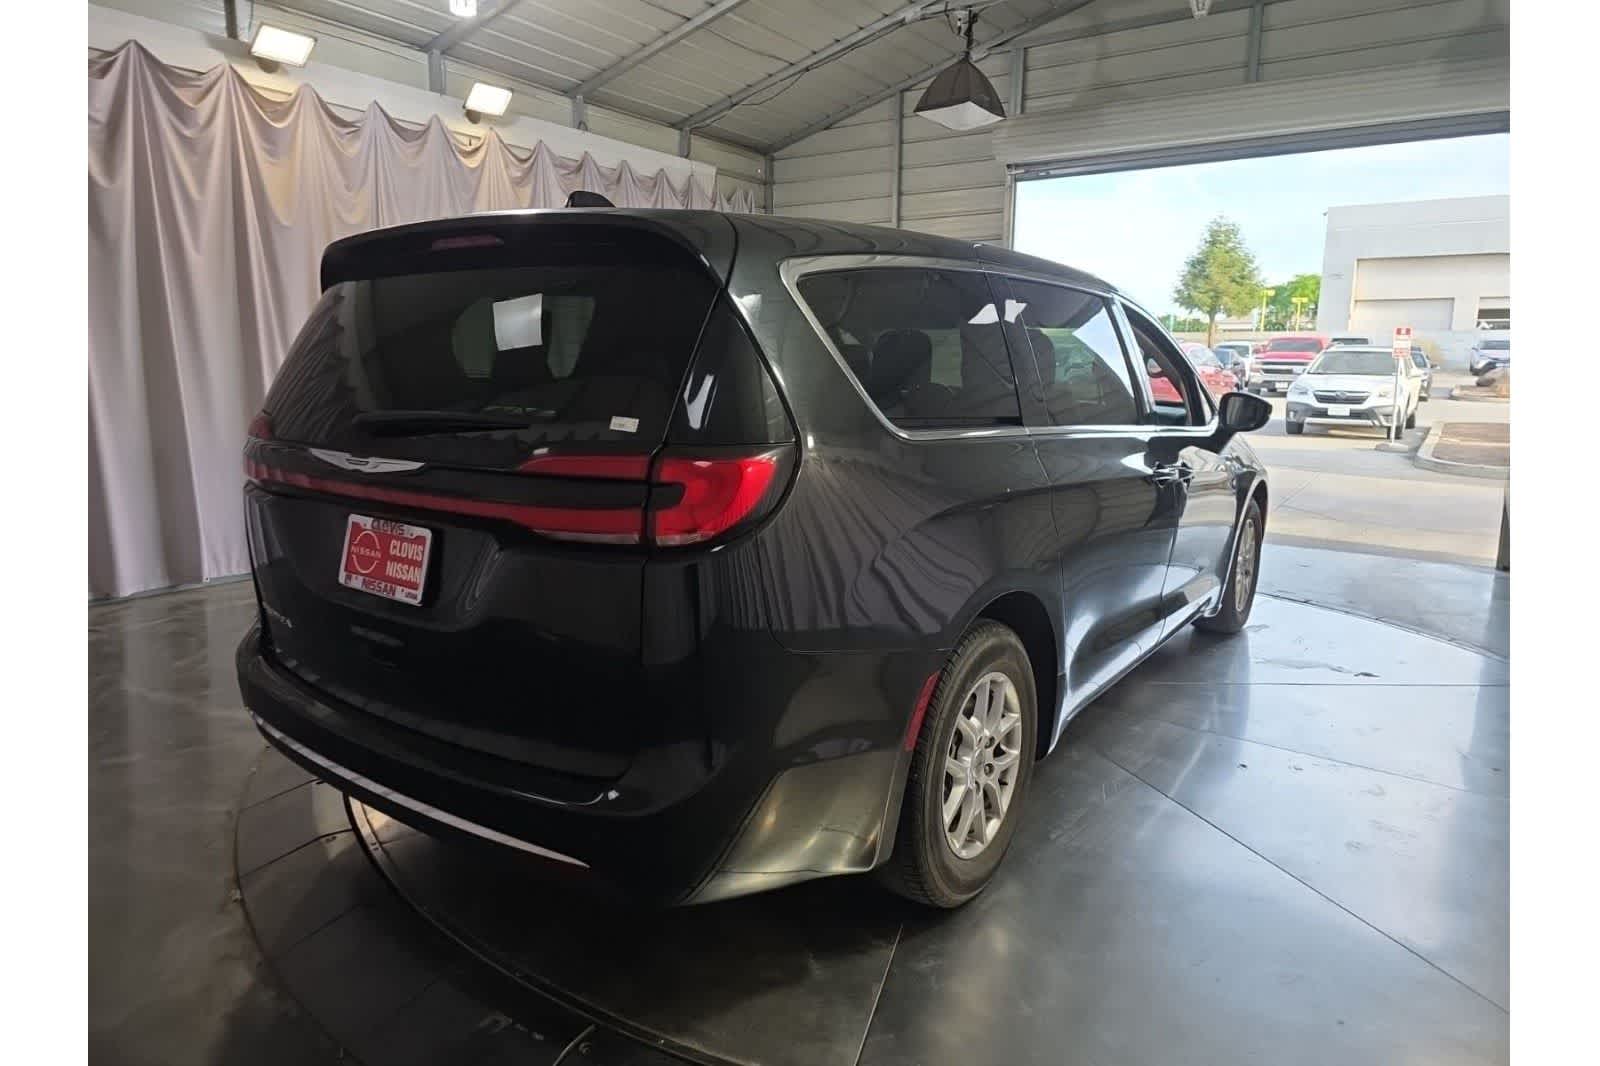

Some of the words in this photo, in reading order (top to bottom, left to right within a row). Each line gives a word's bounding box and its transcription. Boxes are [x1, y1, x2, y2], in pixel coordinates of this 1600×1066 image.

[350, 546, 382, 558] NISSAN
[389, 540, 424, 562] CLOVIS
[385, 560, 421, 584] NISSAN
[361, 578, 396, 597] NISSAN
